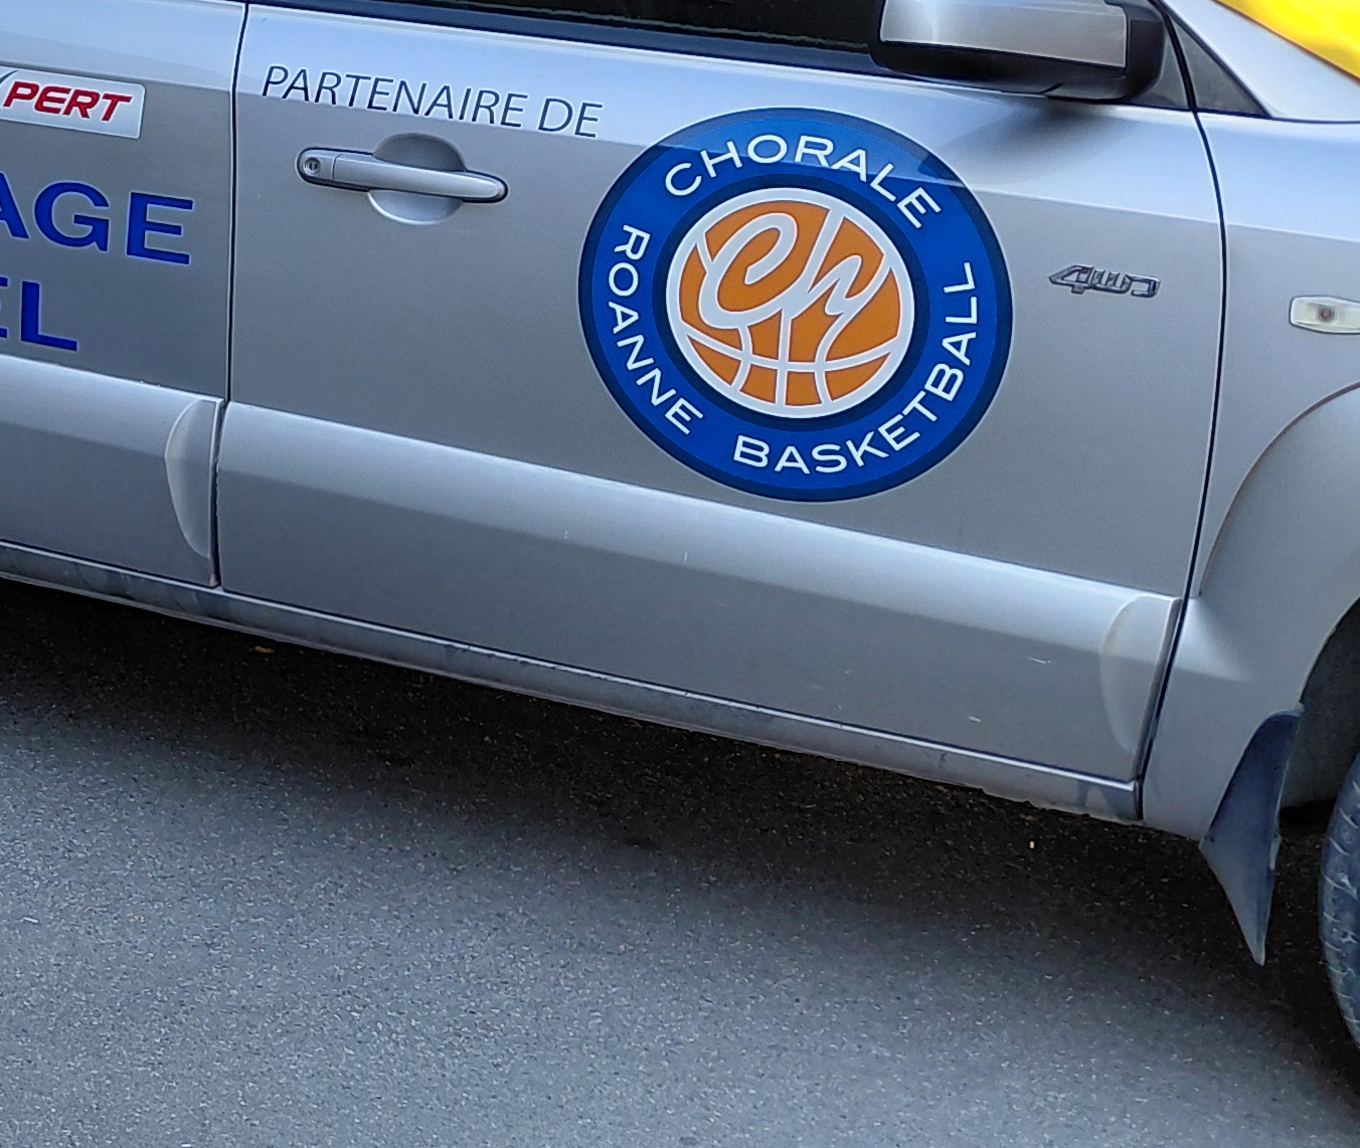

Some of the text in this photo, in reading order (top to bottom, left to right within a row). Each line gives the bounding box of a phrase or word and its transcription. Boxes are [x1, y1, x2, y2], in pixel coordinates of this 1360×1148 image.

[261, 65, 604, 139] PARTENAIRE DE
[664, 134, 942, 230] CHORALE
[1048, 264, 1161, 299] 4WD
[608, 224, 979, 474] ROANNE BASKETBALL
